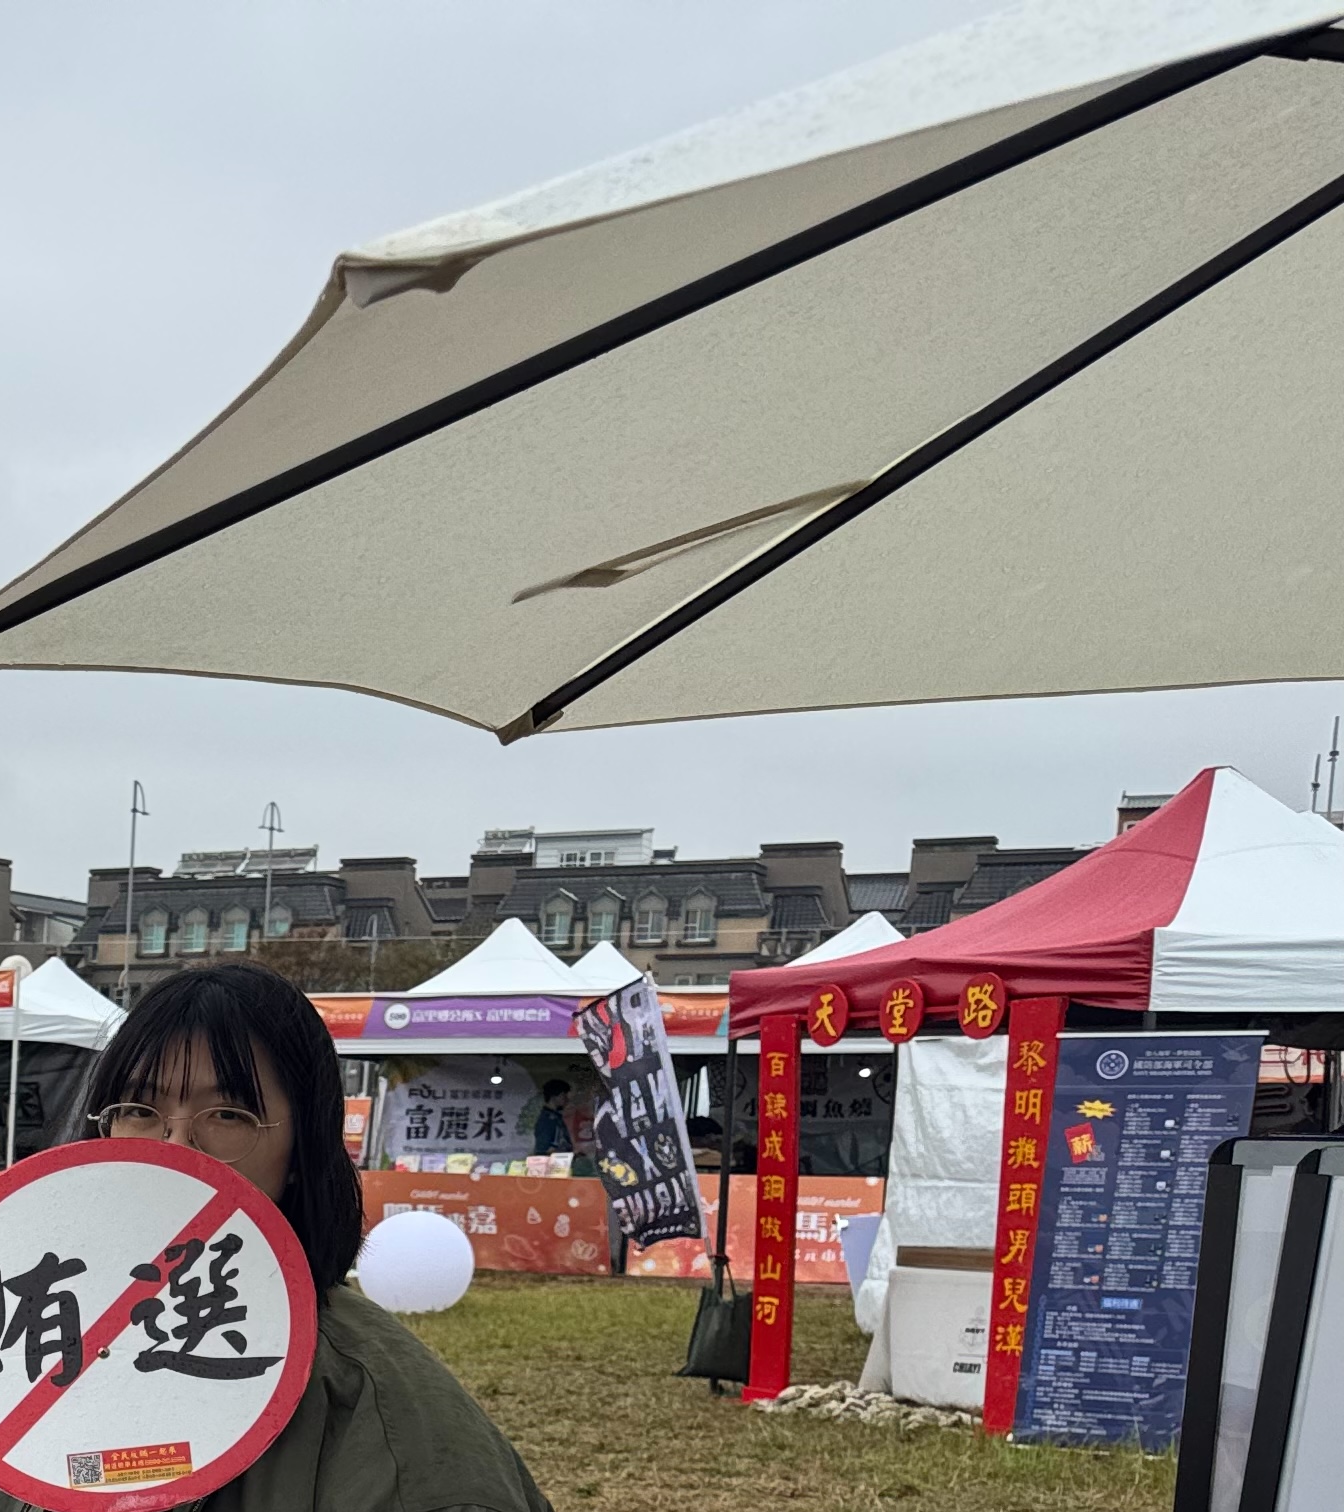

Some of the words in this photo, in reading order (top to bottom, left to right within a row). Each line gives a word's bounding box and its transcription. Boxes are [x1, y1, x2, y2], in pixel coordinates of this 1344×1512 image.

[812, 983, 998, 1037] 天堂路
[405, 1104, 506, 1141] 富麗米
[995, 1041, 1047, 1357] 黎明灘頭男兒漢
